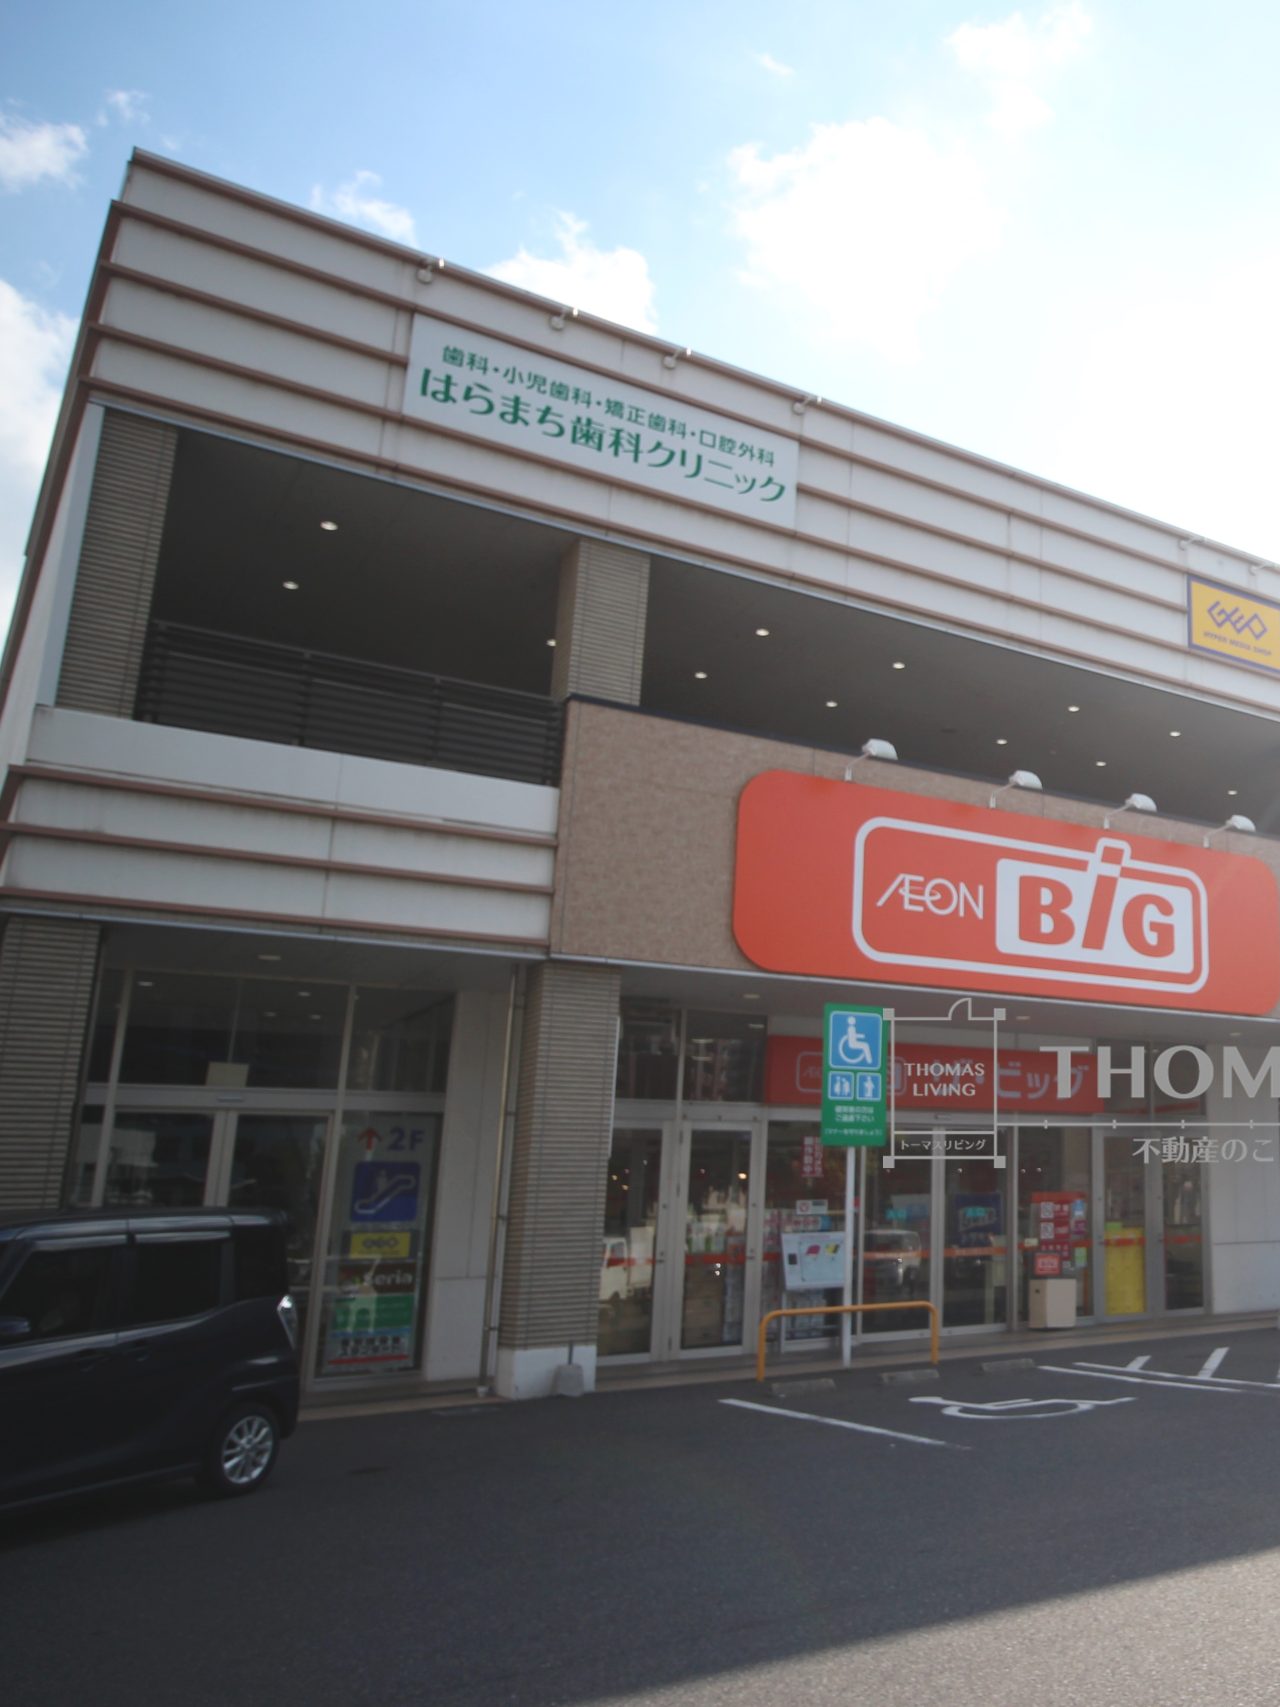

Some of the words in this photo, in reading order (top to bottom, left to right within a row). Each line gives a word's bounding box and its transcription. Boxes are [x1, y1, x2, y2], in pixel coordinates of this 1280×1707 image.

[420, 368, 787, 502] はらまち歯科クリニック
[442, 344, 775, 467] 歯科・小児歯科・矯正歯科・口腔外科
[388, 1126, 425, 1151] 2F
